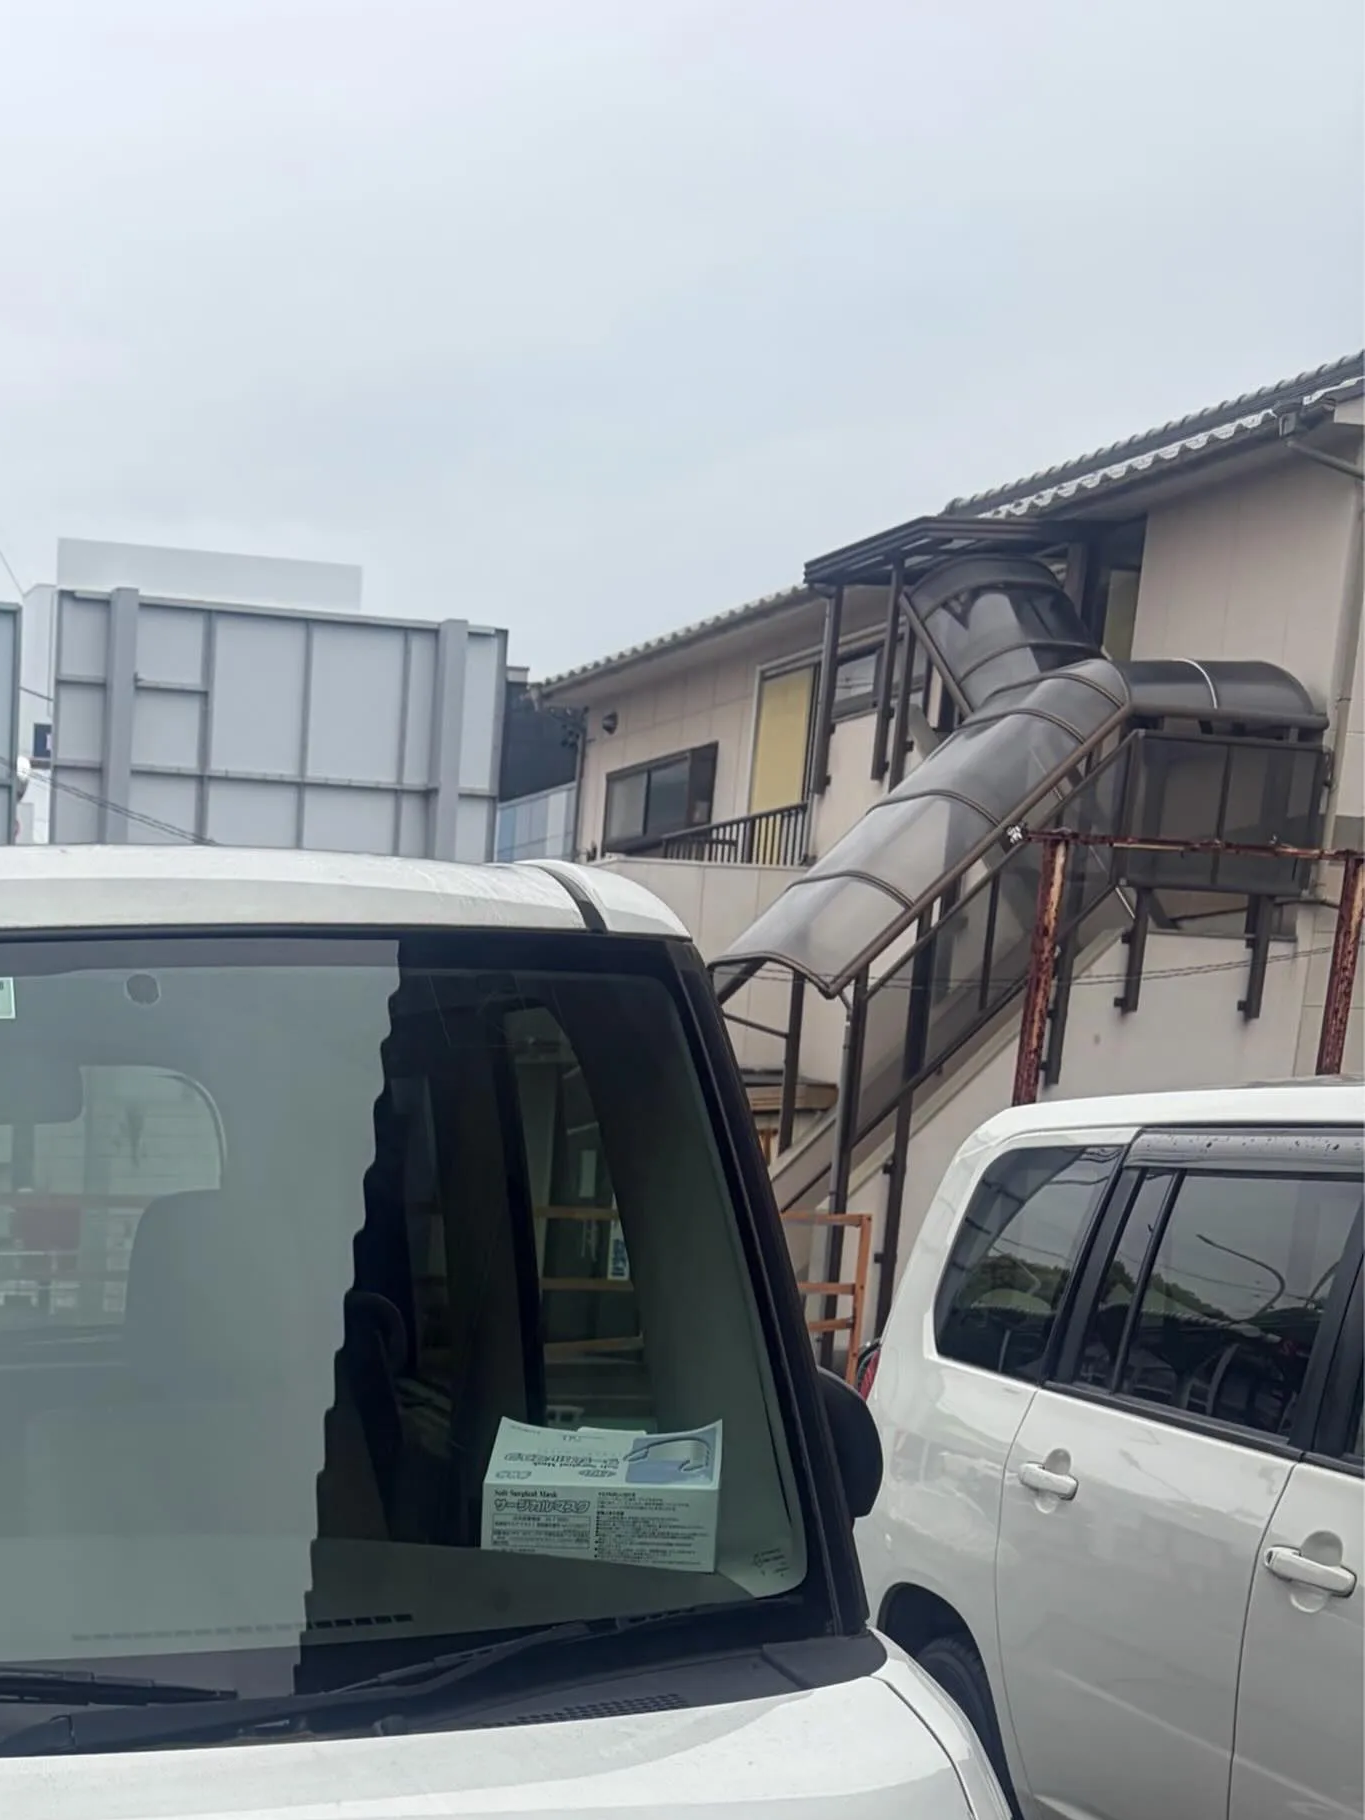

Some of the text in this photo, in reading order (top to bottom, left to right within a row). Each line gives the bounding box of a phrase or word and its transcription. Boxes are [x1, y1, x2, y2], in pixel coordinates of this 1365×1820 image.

[494, 1499, 591, 1514] サージカルマスク
